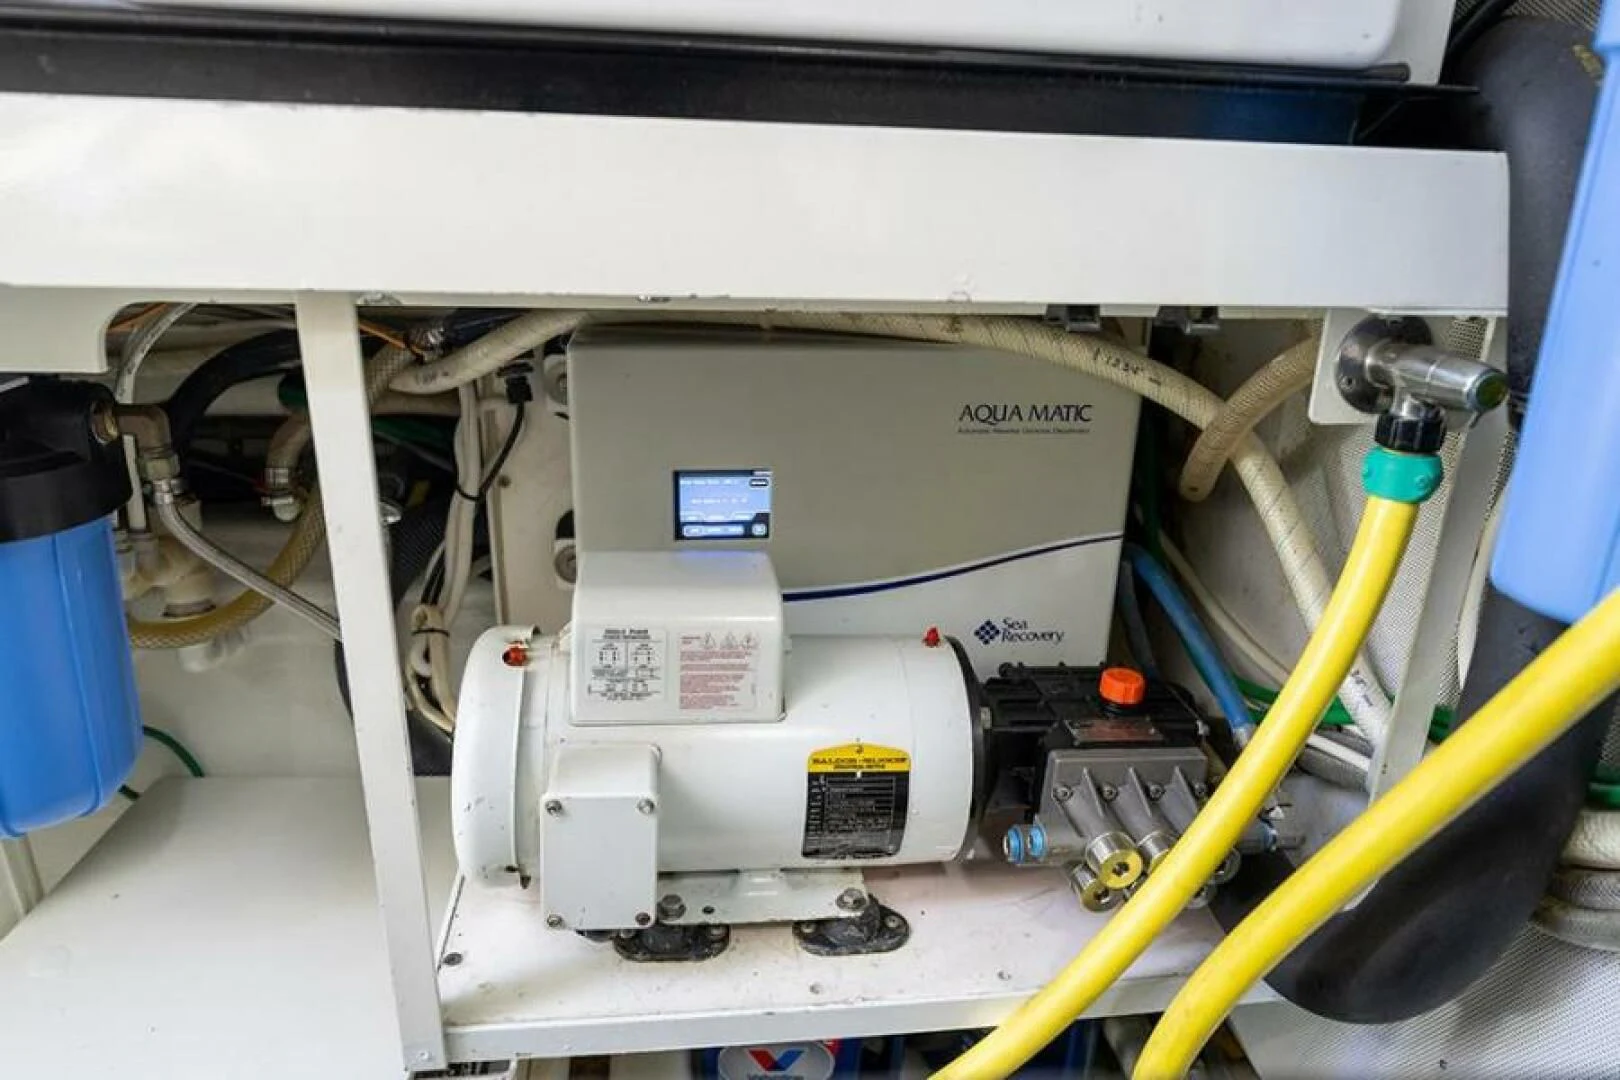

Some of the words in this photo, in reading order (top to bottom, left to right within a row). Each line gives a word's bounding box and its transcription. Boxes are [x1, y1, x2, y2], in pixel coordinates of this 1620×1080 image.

[958, 403, 1023, 425] AQUA
[1028, 403, 1093, 423] MATIC
[1002, 616, 1028, 630] Sea
[1002, 628, 1065, 645] Recovery
